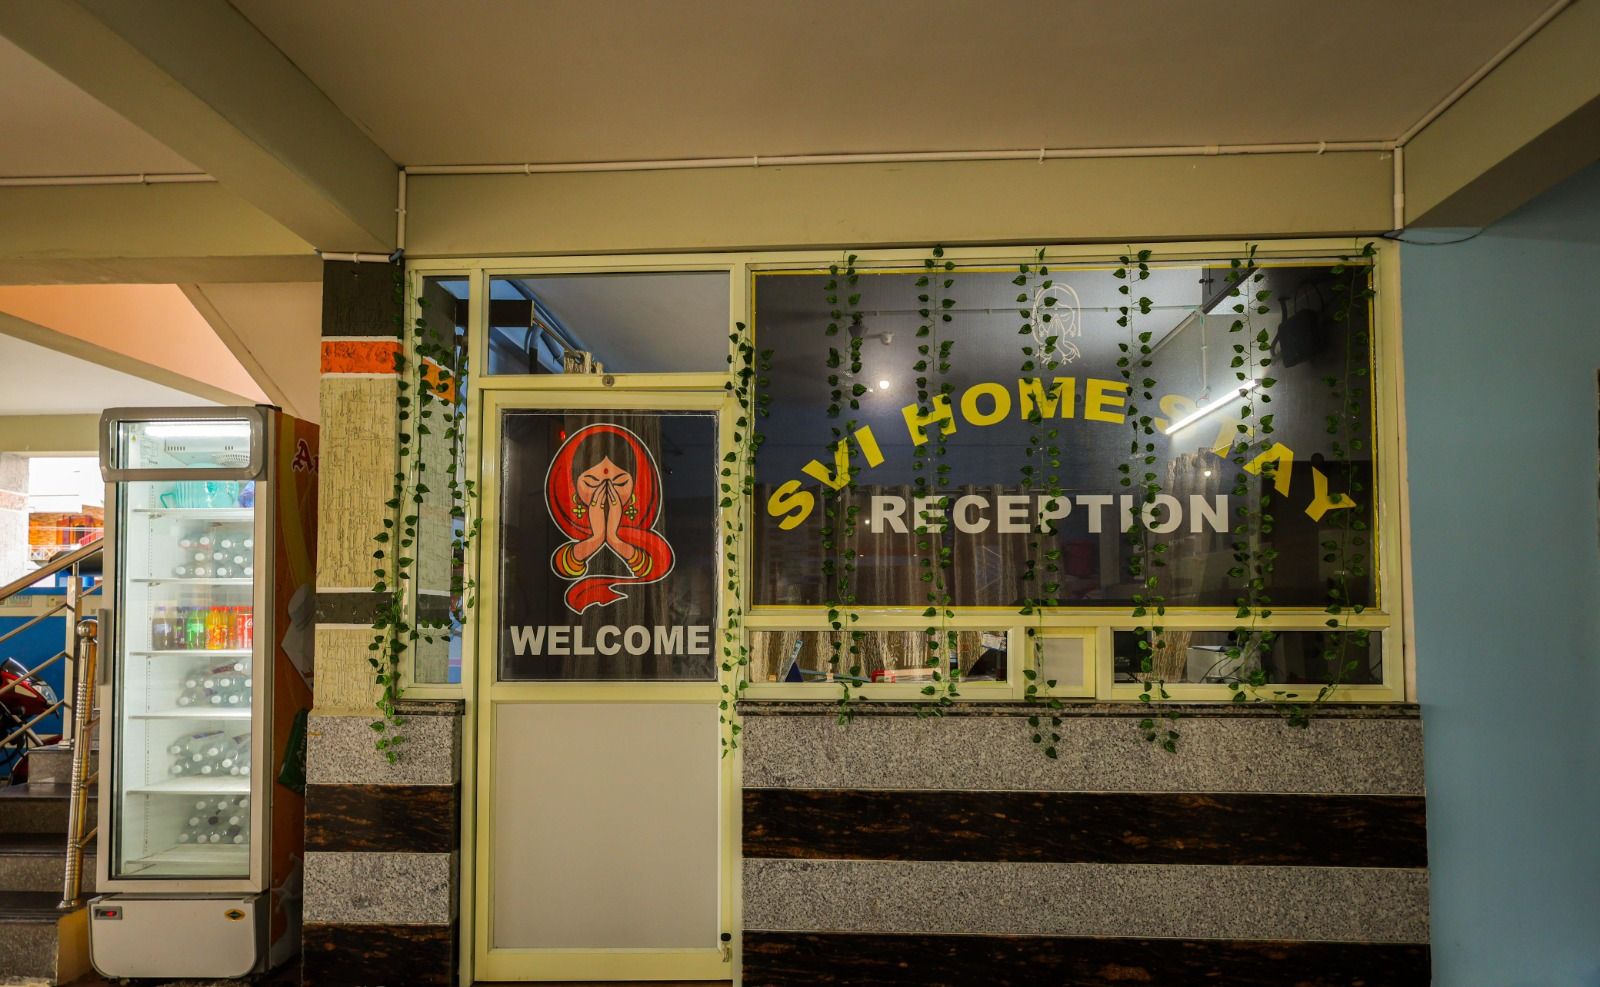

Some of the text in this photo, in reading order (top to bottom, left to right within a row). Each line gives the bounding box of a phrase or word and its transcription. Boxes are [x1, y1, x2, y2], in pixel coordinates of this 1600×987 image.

[767, 424, 885, 530] SVI
[902, 376, 1129, 446] HOME
[871, 494, 1229, 534] RECEPTION
[510, 625, 710, 656] WELCOME
